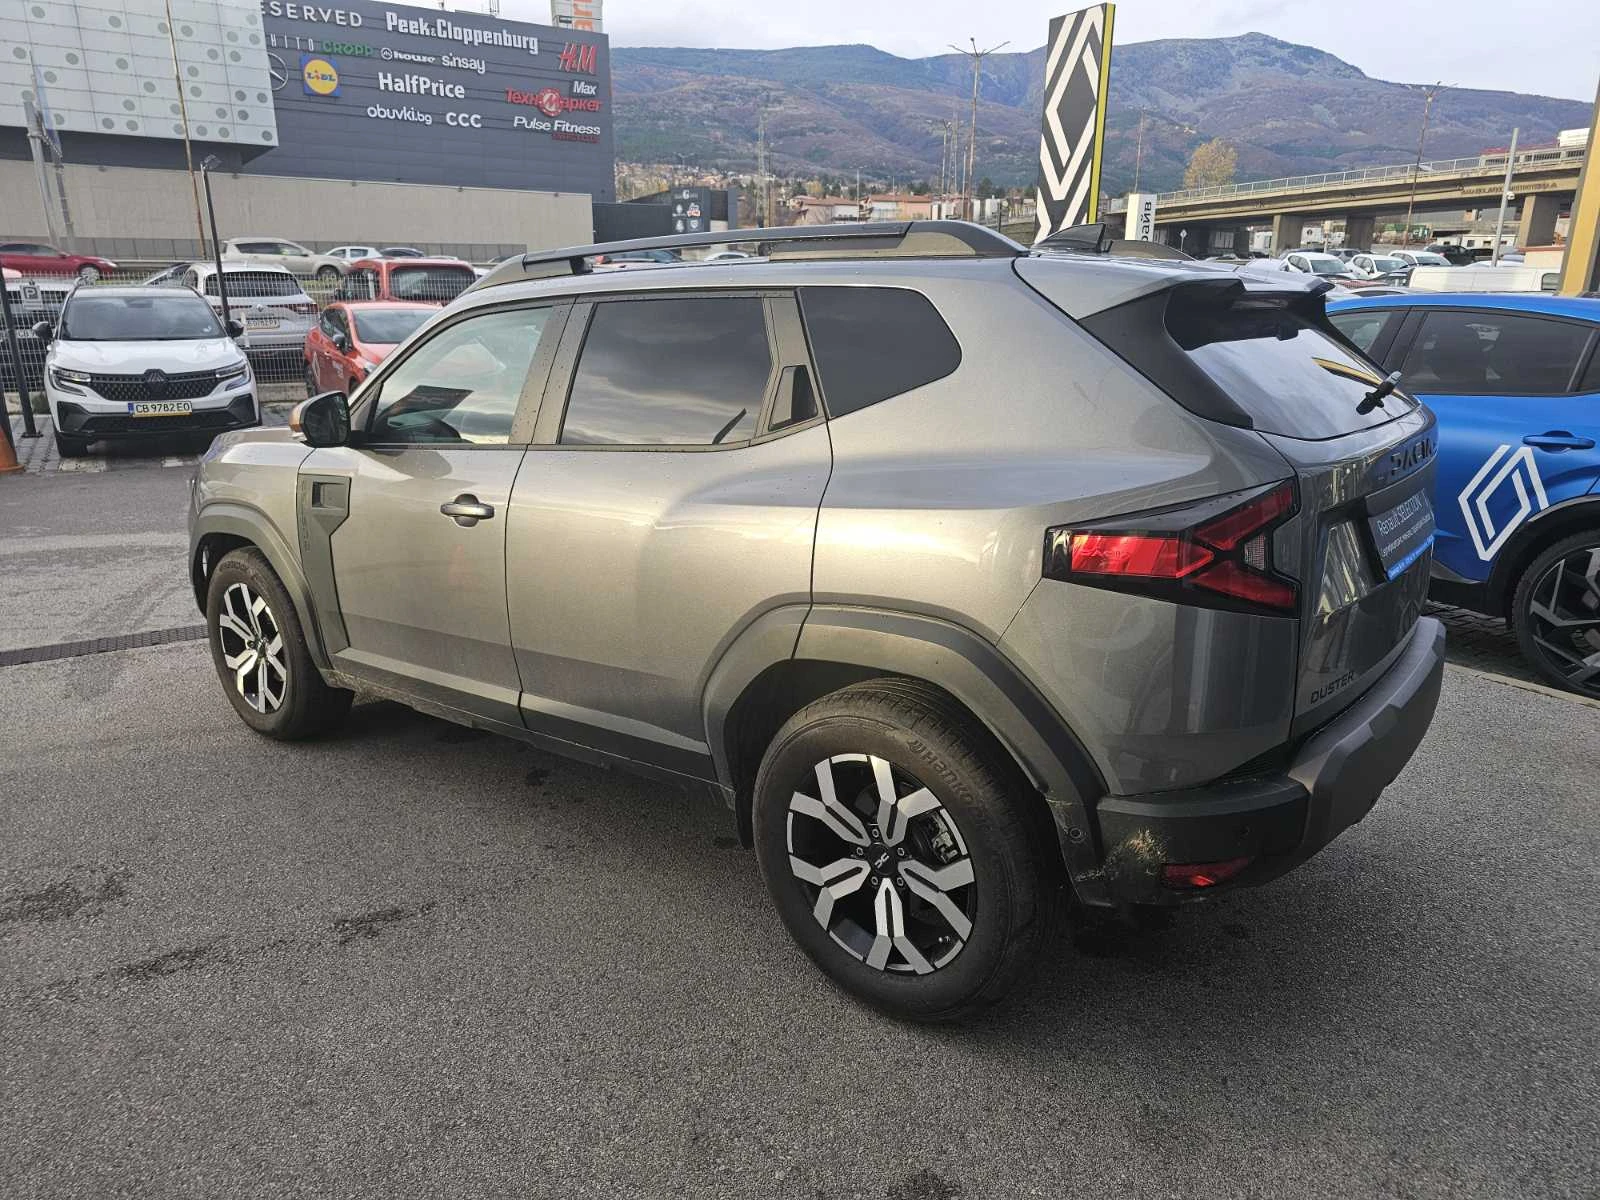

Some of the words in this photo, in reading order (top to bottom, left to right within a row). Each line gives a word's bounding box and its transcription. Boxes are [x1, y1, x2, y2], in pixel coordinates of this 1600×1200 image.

[441, 53, 486, 74] sinsay
[559, 42, 598, 75] H&M
[378, 72, 465, 99] HalfPrice
[573, 81, 597, 95] Max
[367, 104, 433, 125] obuvki.bg
[446, 112, 482, 128] CCC
[513, 116, 551, 131] Pulse
[553, 120, 601, 135] Fitness
[1310, 671, 1354, 704] DUSTER
